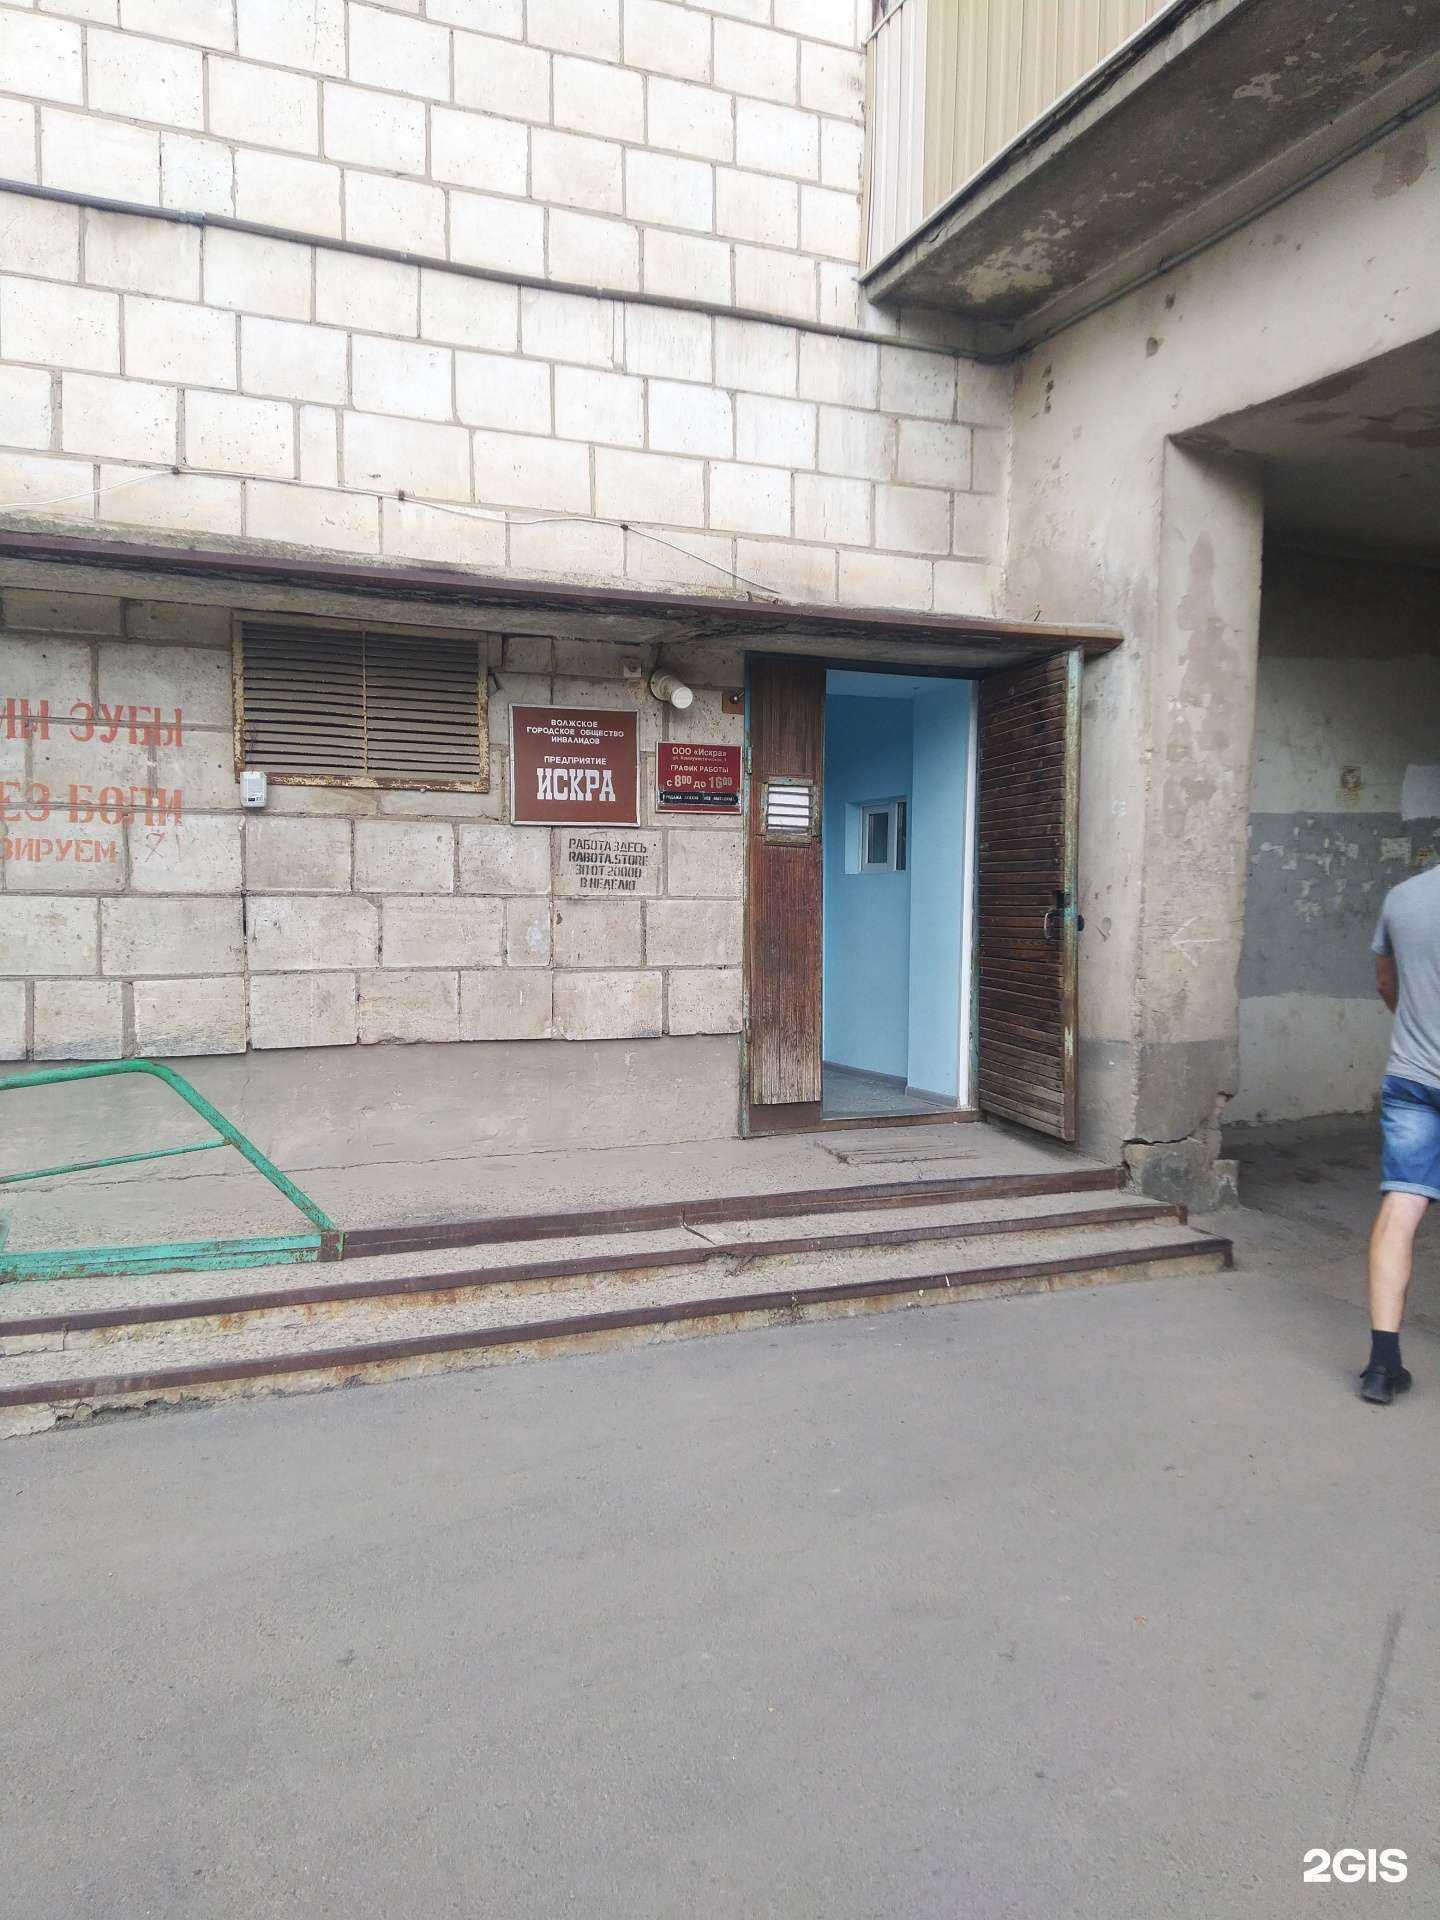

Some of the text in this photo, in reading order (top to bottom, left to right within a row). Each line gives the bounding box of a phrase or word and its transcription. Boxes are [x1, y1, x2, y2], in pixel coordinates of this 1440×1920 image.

[69, 702, 183, 747] ЗУБЫ
[551, 719, 598, 728] ВОЛЖСКОЕ
[526, 726, 624, 738] ГОРОДСКОЕ ОБЩЕСТВО
[551, 736, 600, 745] ИНВАЛИДОВ
[671, 746, 692, 756] ООО
[544, 755, 608, 765] ПРЕДПРИЯТИЕ
[670, 764, 729, 773] ГРАФИК РАБОТЫ
[536, 767, 616, 802] ИСКРА
[693, 780, 707, 789] до
[69, 784, 184, 826] БОЛИ
[568, 838, 612, 852] РАБОТА
